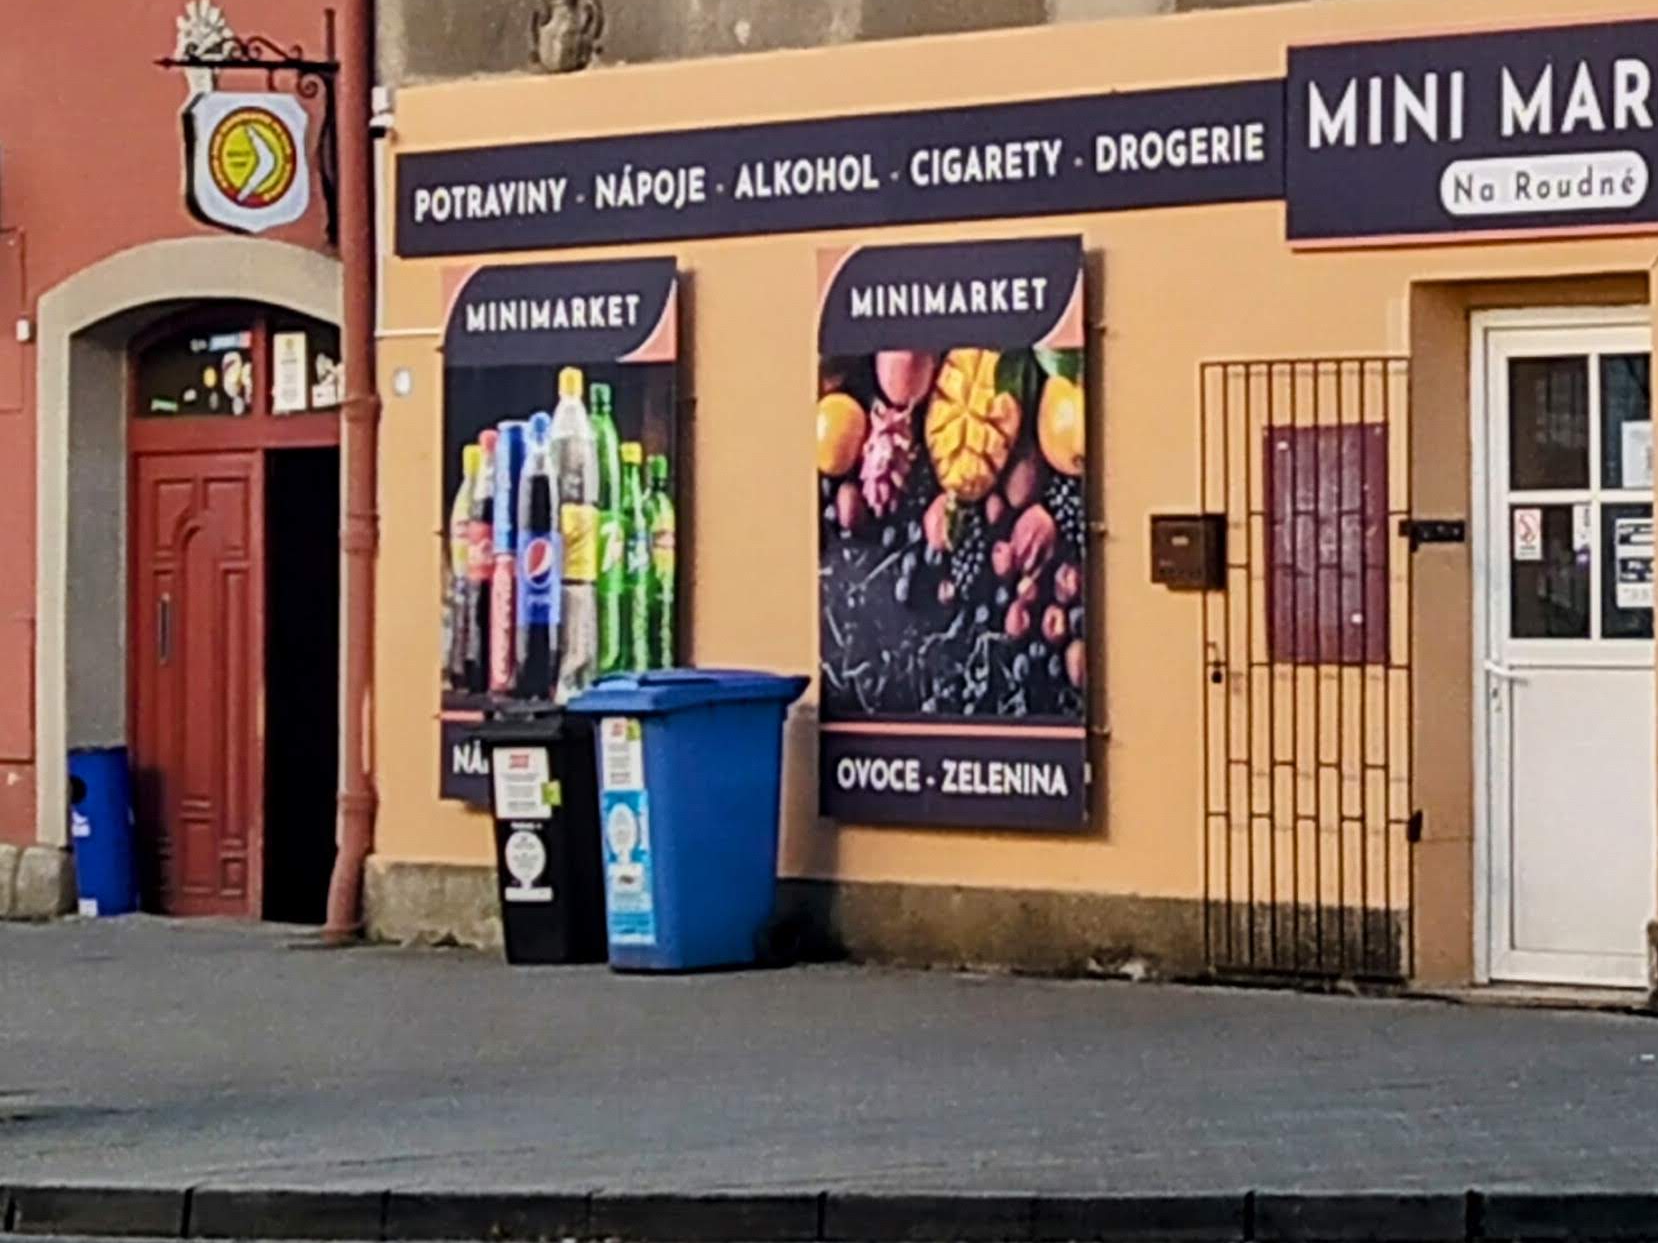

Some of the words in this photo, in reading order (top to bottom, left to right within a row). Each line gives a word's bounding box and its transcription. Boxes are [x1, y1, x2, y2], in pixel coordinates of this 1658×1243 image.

[1307, 71, 1464, 148] MINI
[414, 178, 567, 223] POTRAVINY
[594, 164, 706, 210] NÁPOJE
[735, 154, 879, 200] ALKOHOL
[910, 139, 1062, 186] CIGARETY
[1095, 123, 1264, 173] DROGERIE
[1452, 172, 1495, 204] Na
[1514, 165, 1636, 201] Roudné
[466, 295, 640, 332] MINIMARKET
[850, 278, 1047, 317] MINIMARKET
[837, 758, 920, 791] OVOCE
[942, 759, 1068, 796] ZELENINA
